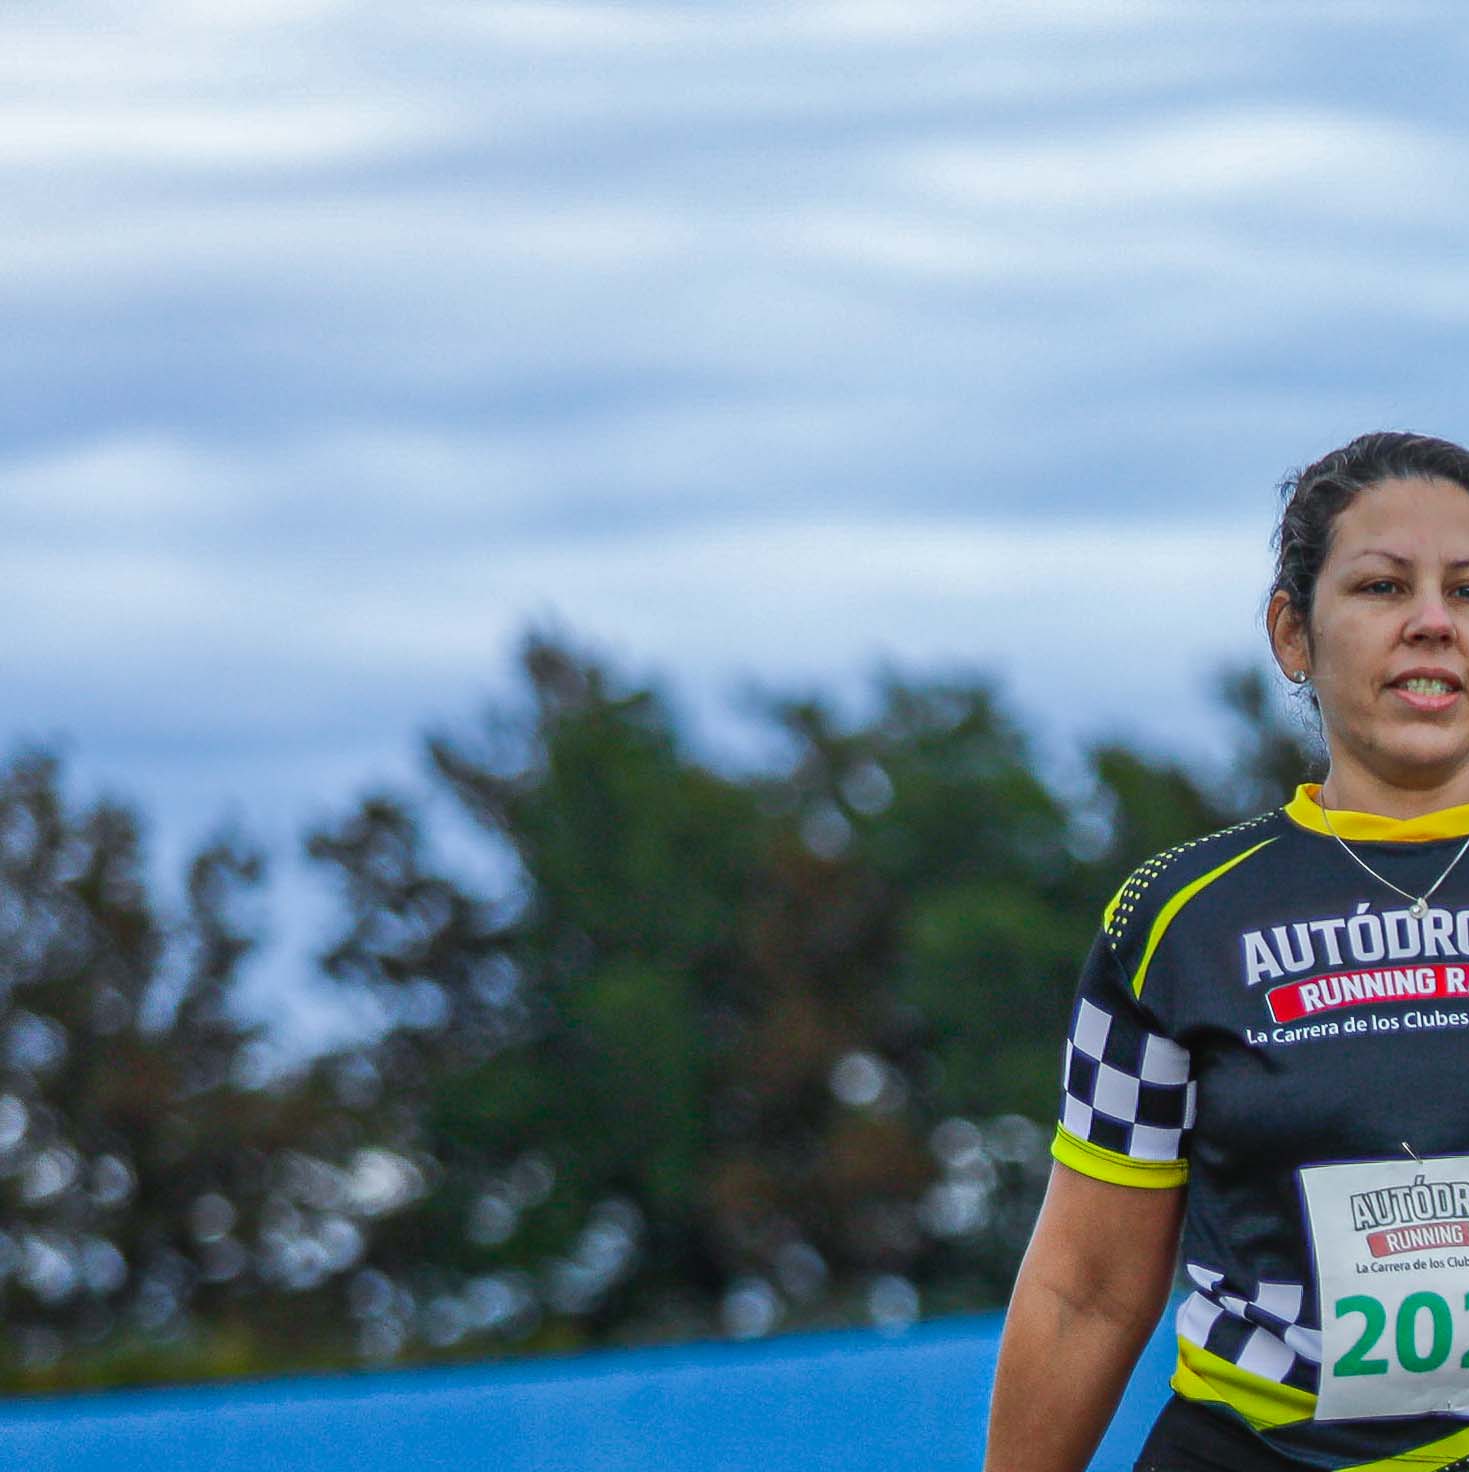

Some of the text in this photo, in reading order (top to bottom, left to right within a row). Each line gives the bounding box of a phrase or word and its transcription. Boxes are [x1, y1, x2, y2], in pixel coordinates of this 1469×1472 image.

[1299, 967, 1436, 1013] RUNNING
[1246, 1028, 1268, 1044] La
[1272, 1022, 1339, 1043] Carrera
[1343, 1016, 1368, 1033] de
[1372, 1014, 1400, 1031] los
[1403, 1010, 1469, 1028] Clubes
[1386, 1224, 1463, 1252] RUNNING
[1355, 1263, 1369, 1275] La
[1370, 1260, 1412, 1273] Carrera
[1413, 1258, 1428, 1271] de
[1429, 1257, 1446, 1270] los
